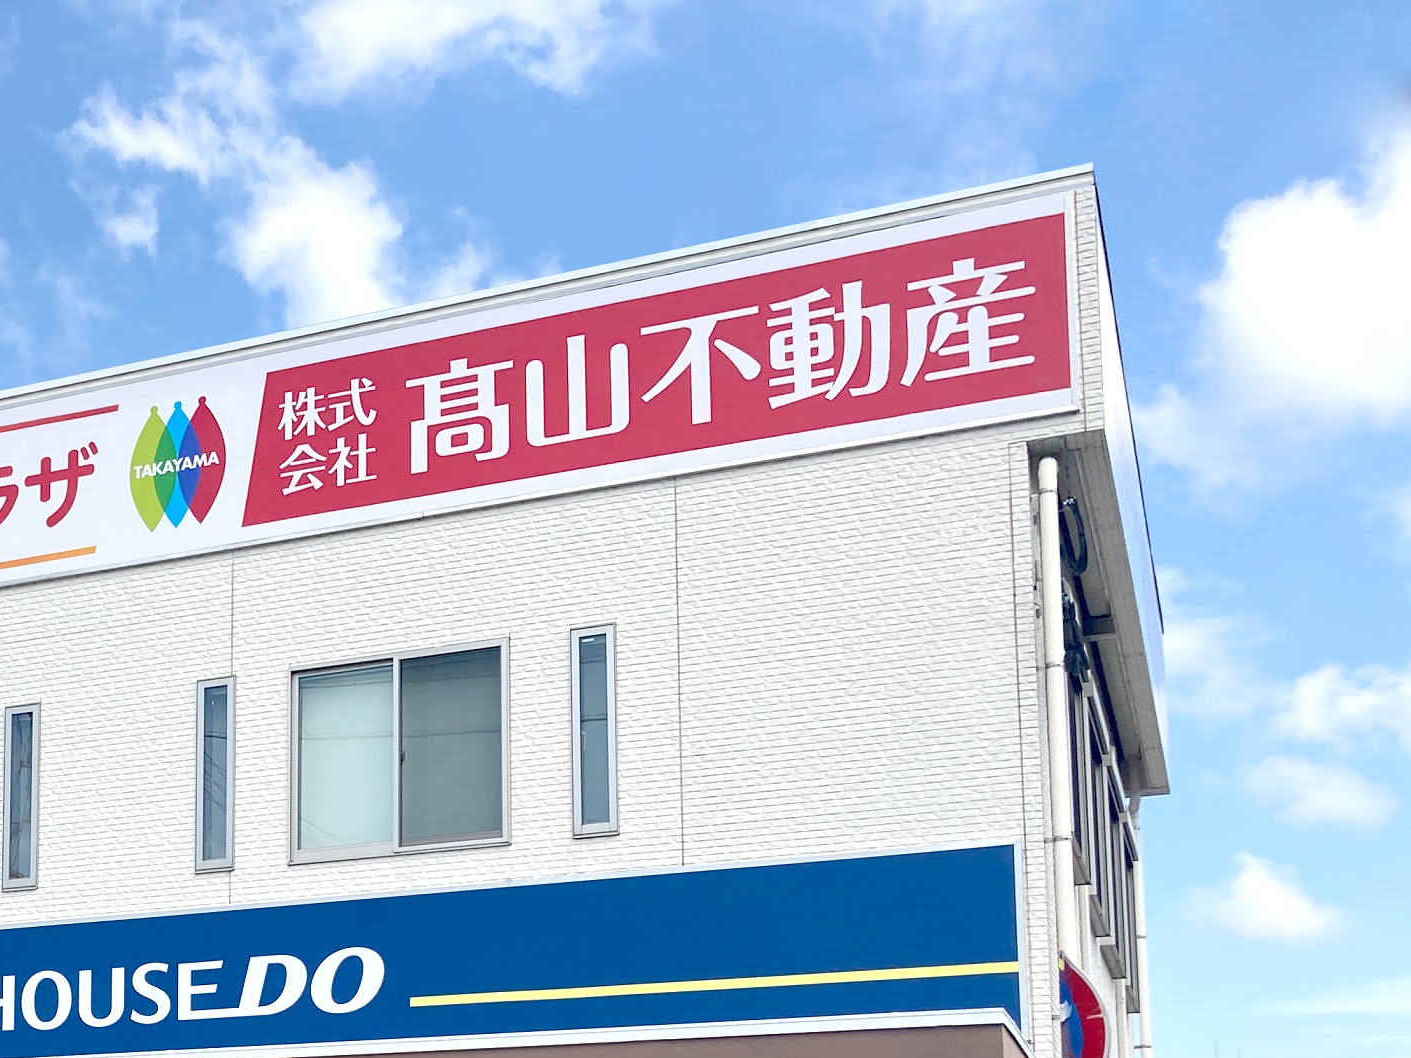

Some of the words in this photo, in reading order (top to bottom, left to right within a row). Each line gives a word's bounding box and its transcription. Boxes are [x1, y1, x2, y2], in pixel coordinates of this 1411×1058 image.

[278, 377, 376, 440] 株式
[133, 450, 220, 478] TAKAYAMA
[279, 434, 377, 496] 会社
